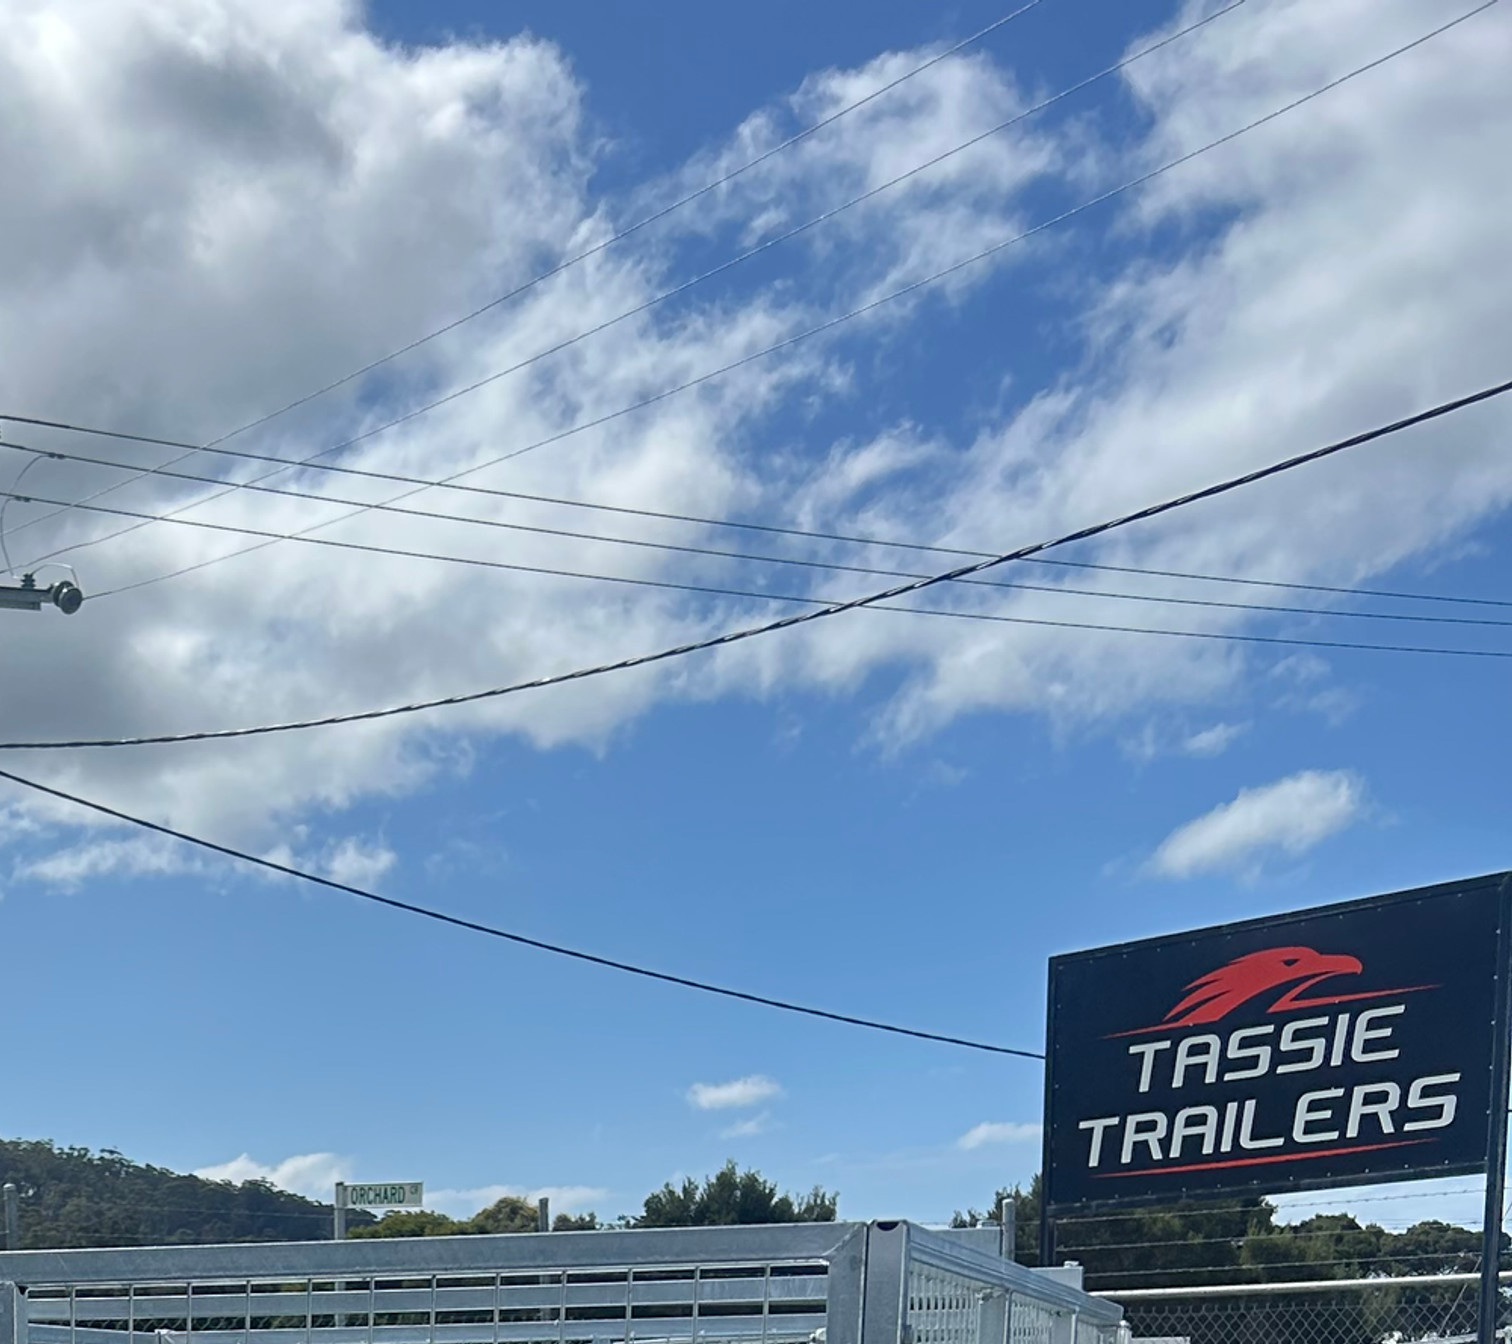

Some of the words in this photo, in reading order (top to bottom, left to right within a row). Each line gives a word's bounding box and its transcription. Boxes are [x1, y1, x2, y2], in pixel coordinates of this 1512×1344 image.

[1128, 1004, 1406, 1093] TASSIE
[1077, 1073, 1461, 1168] TRAILERS
[350, 1186, 405, 1205] ORCHARD
